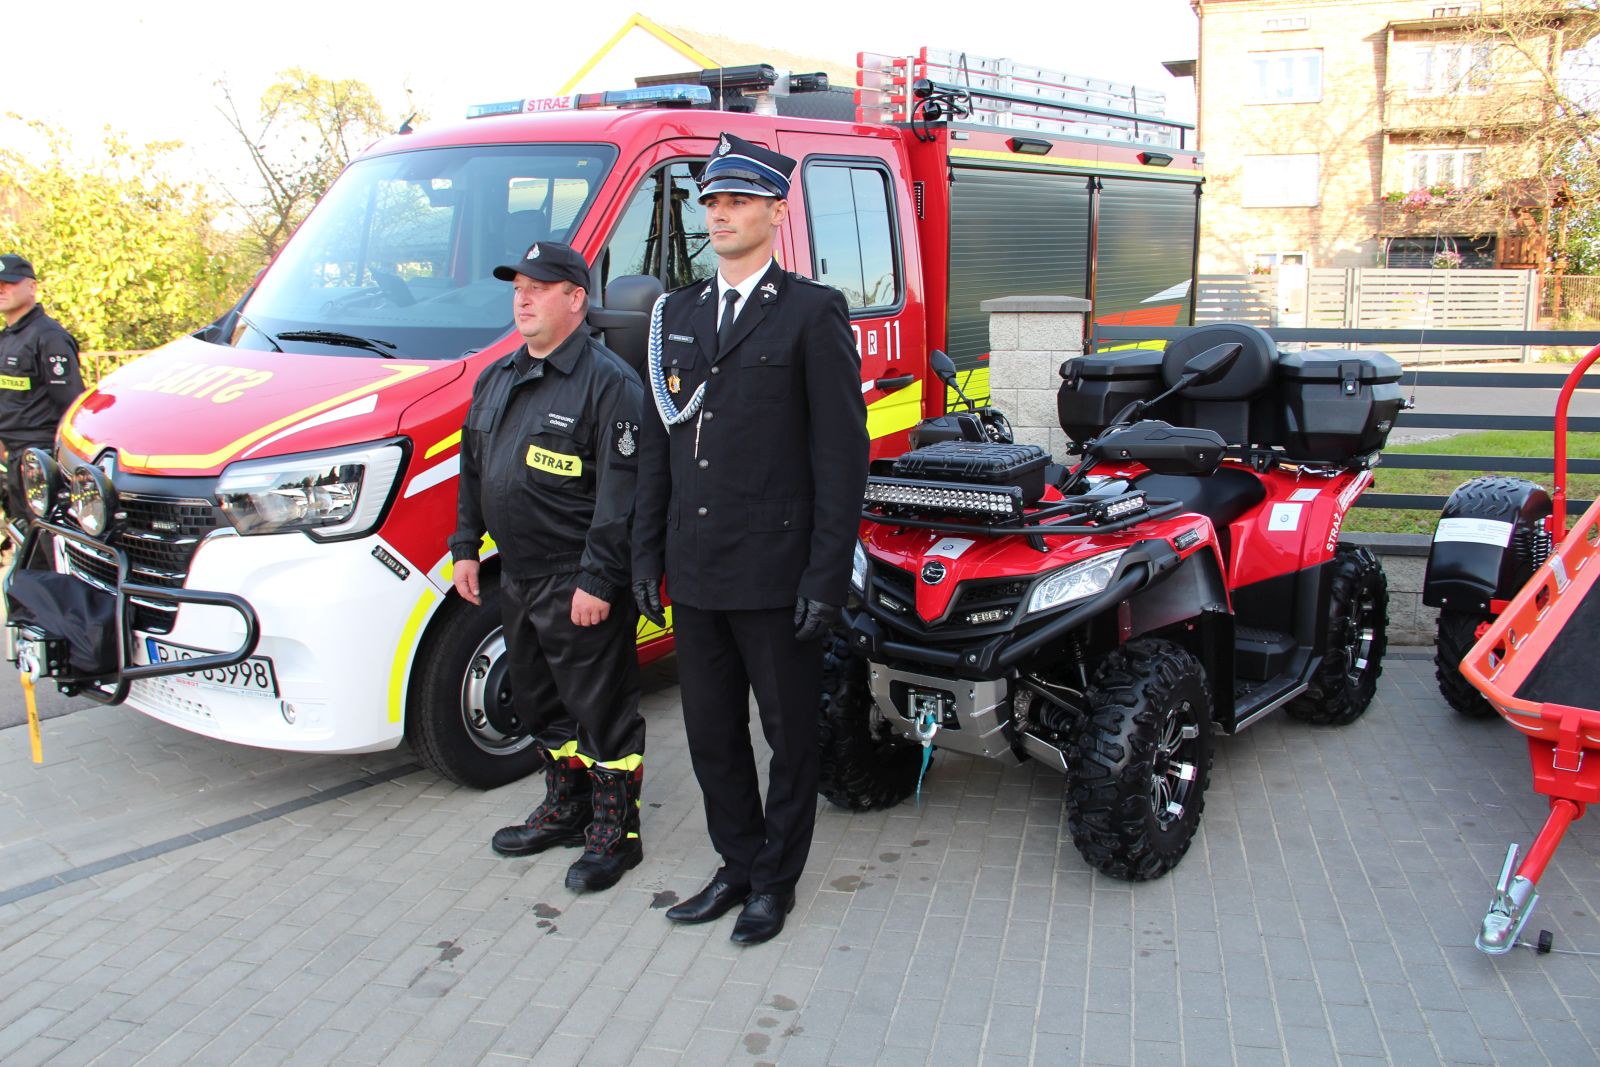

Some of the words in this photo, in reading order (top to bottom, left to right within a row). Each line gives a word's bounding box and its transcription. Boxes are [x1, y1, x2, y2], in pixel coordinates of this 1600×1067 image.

[869, 331, 877, 354] R
[884, 320, 900, 361] 11
[616, 421, 639, 432] OSP
[1326, 512, 1342, 552] STRAŻ
